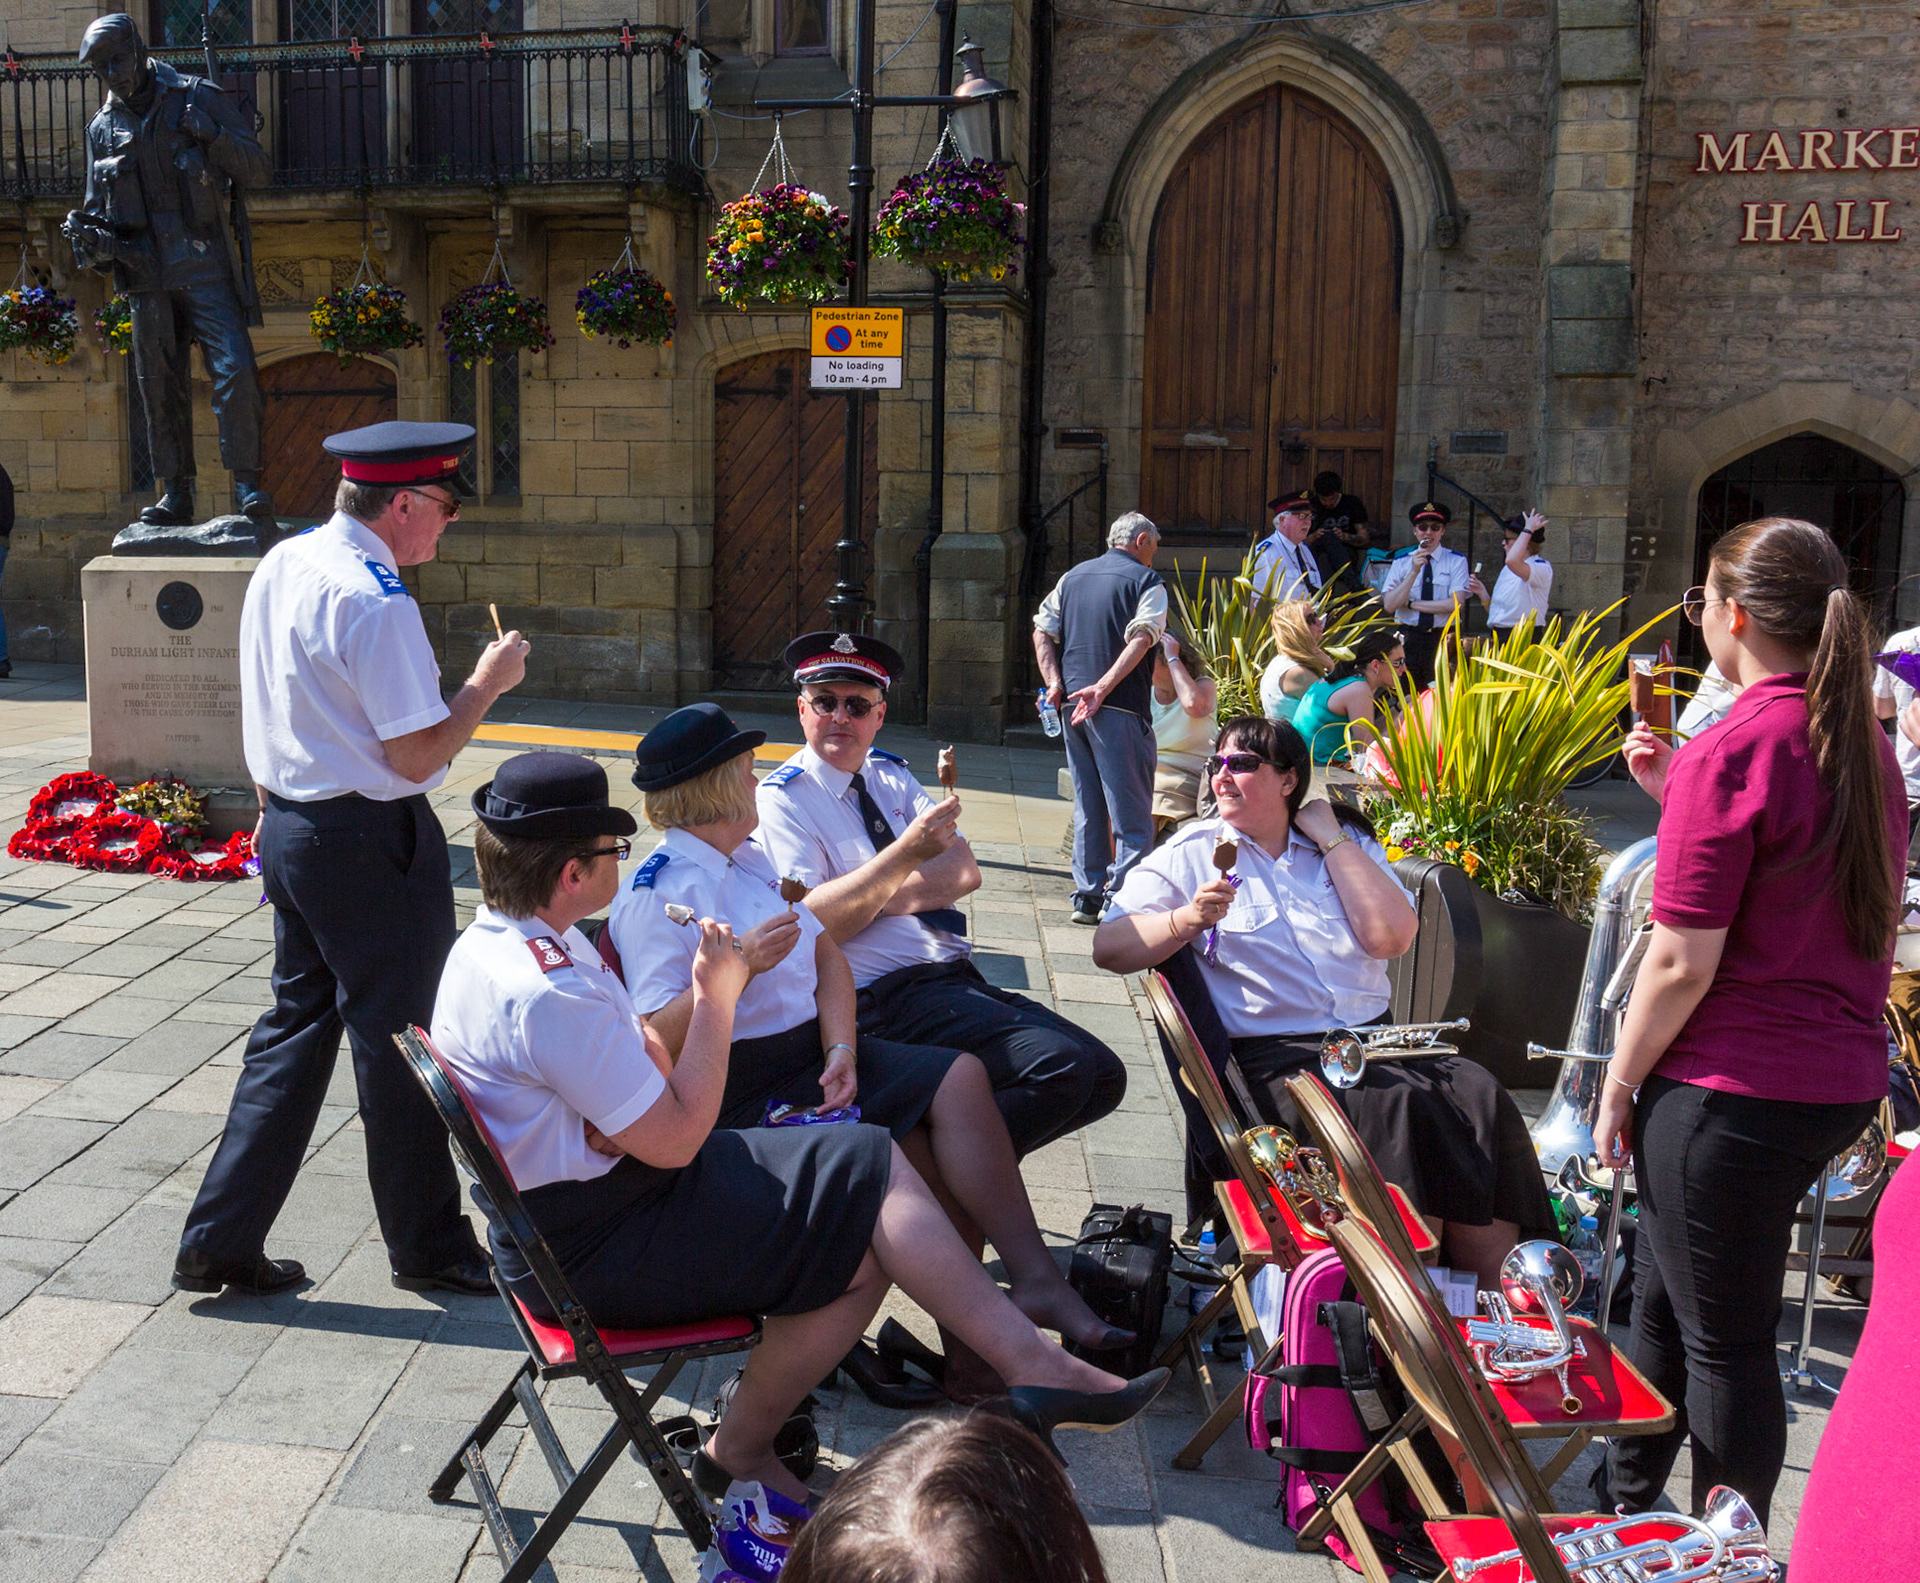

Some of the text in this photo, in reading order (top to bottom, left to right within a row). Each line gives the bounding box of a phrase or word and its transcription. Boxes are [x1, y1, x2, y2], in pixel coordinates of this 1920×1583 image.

[1694, 127, 1920, 174] MARKE
[1739, 200, 1902, 244] HALL
[816, 311, 899, 321] Pedestrian Zone
[855, 329, 889, 339] At any
[860, 340, 883, 348] time
[828, 361, 884, 371] No loading
[169, 635, 192, 646] THE
[111, 647, 241, 659] DURHAM LIGHT INFANT
[821, 656, 865, 666] SALVATION
[866, 664, 883, 675] ARMY
[145, 674, 190, 682] DEDICATED
[145, 691, 161, 699] AND
[124, 700, 149, 708] THOSE
[151, 700, 169, 708] WHO
[171, 700, 192, 708] GAVE
[131, 708, 236, 718] IN THE CAUSE OF FREEDOM
[745, 1540, 788, 1568] Milk
